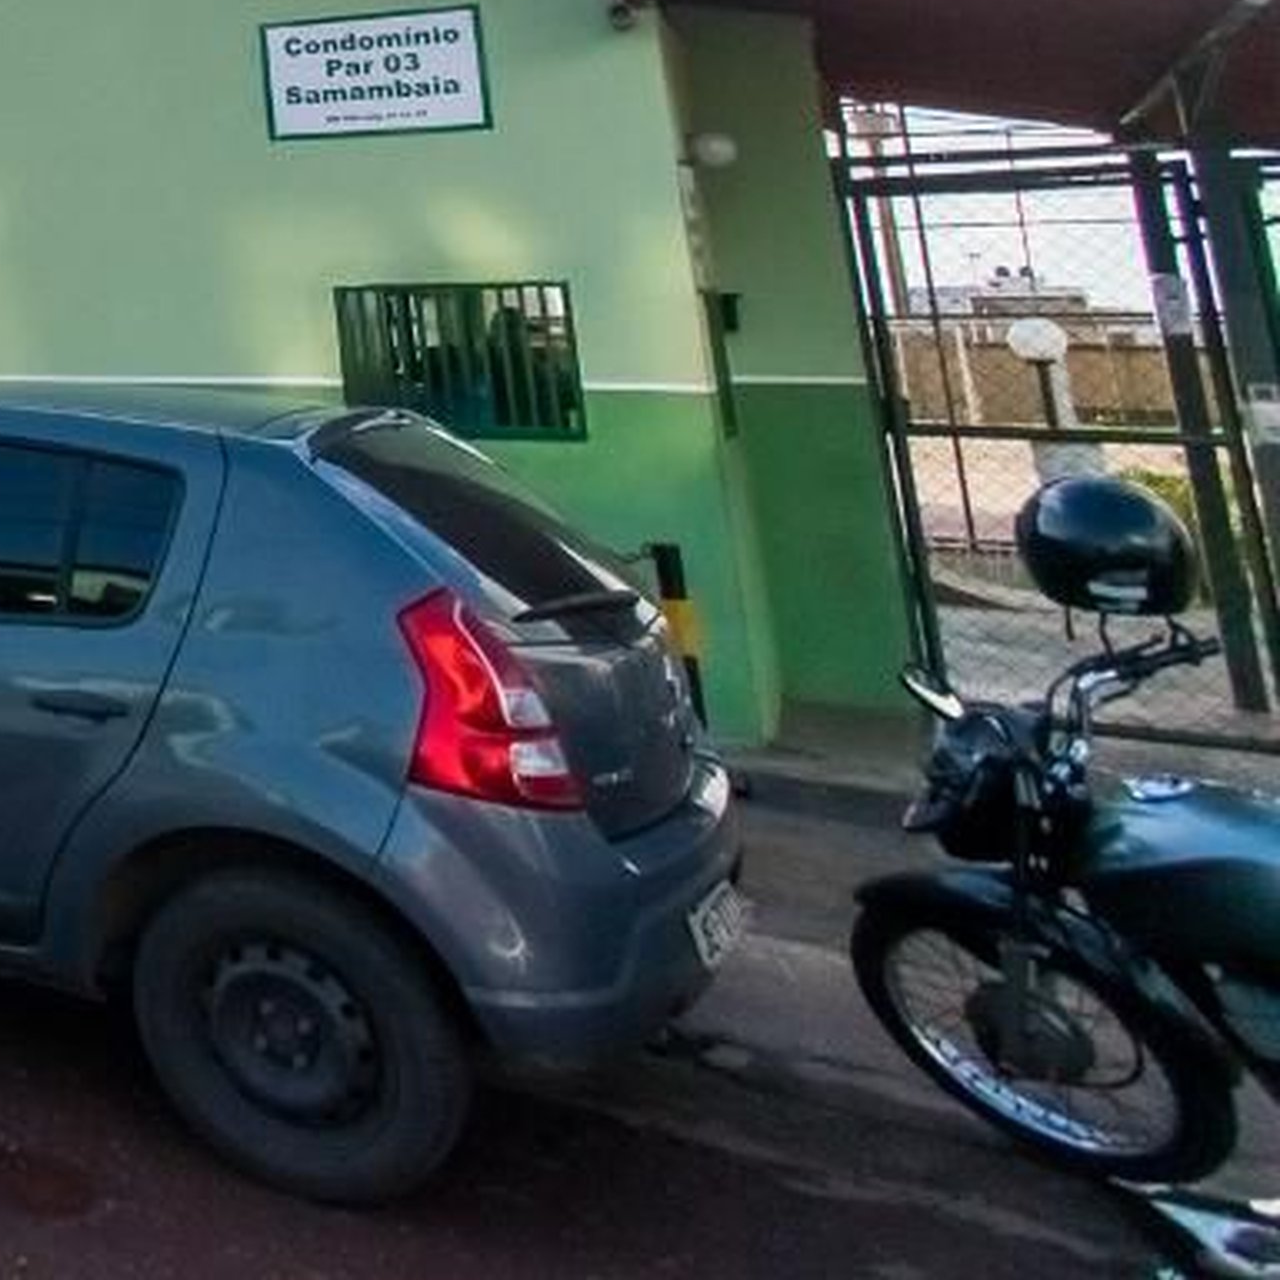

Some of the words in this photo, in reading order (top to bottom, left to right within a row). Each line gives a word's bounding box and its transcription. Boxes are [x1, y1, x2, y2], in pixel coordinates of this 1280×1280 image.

[325, 58, 374, 77] Par
[383, 52, 421, 74] 03
[285, 76, 461, 105] Samambaia
